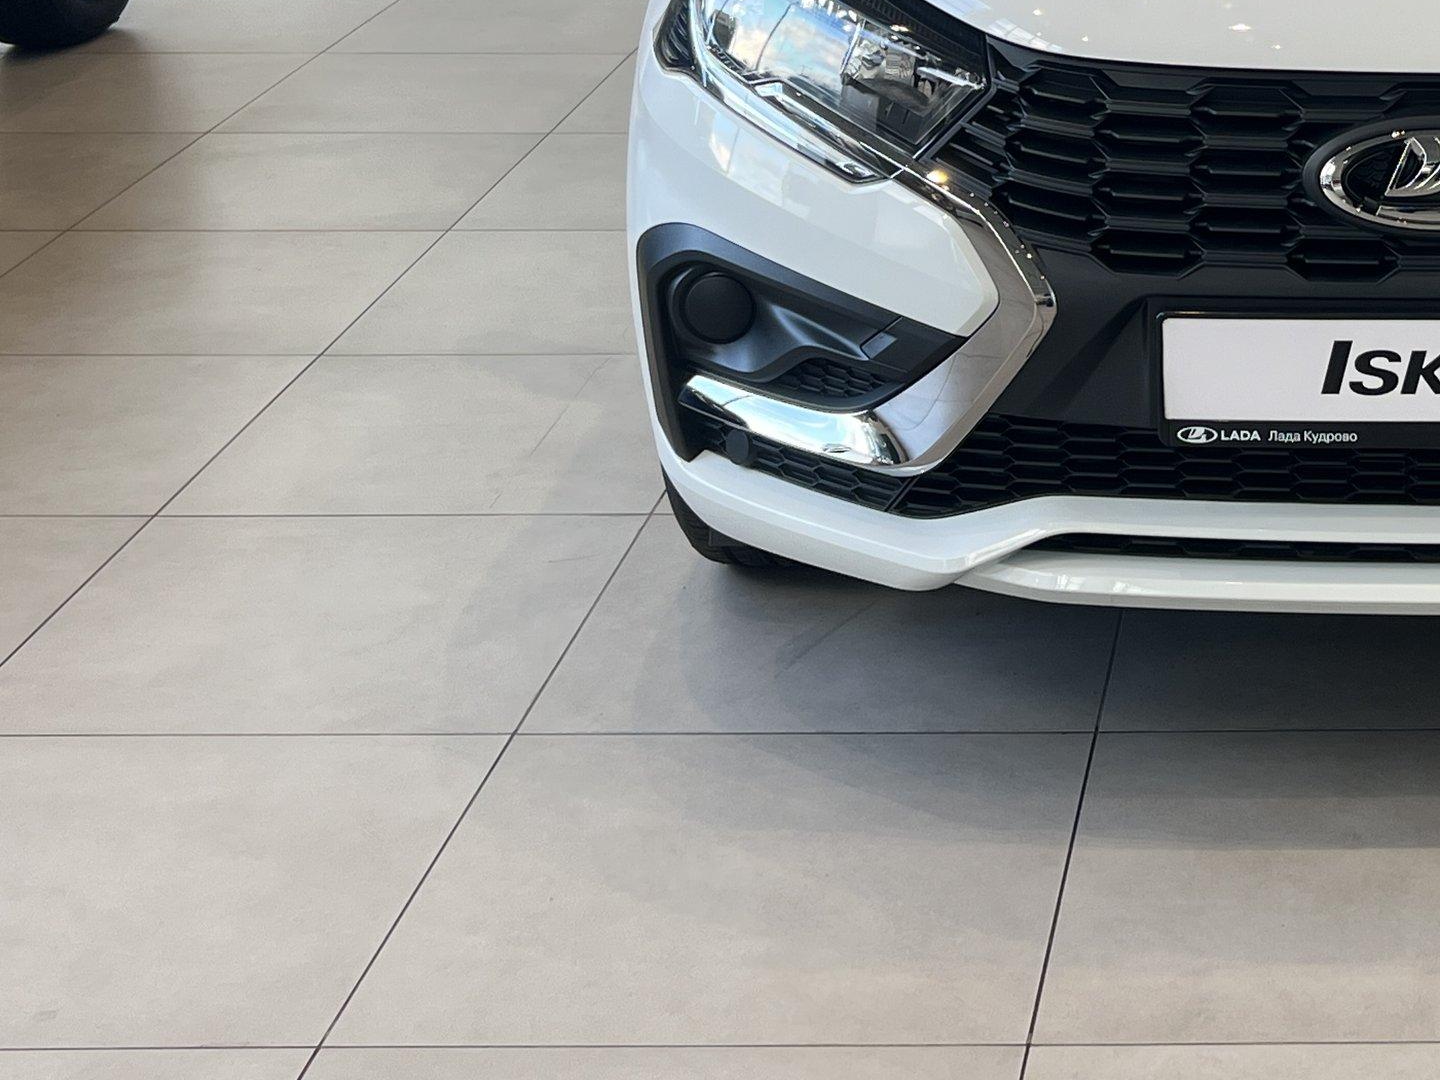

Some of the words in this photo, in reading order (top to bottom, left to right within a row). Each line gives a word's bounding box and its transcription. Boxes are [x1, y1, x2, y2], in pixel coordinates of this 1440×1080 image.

[1221, 430, 1261, 441] LADA
[1268, 430, 1301, 443] Лада
[1304, 430, 1358, 443] Кудрово
